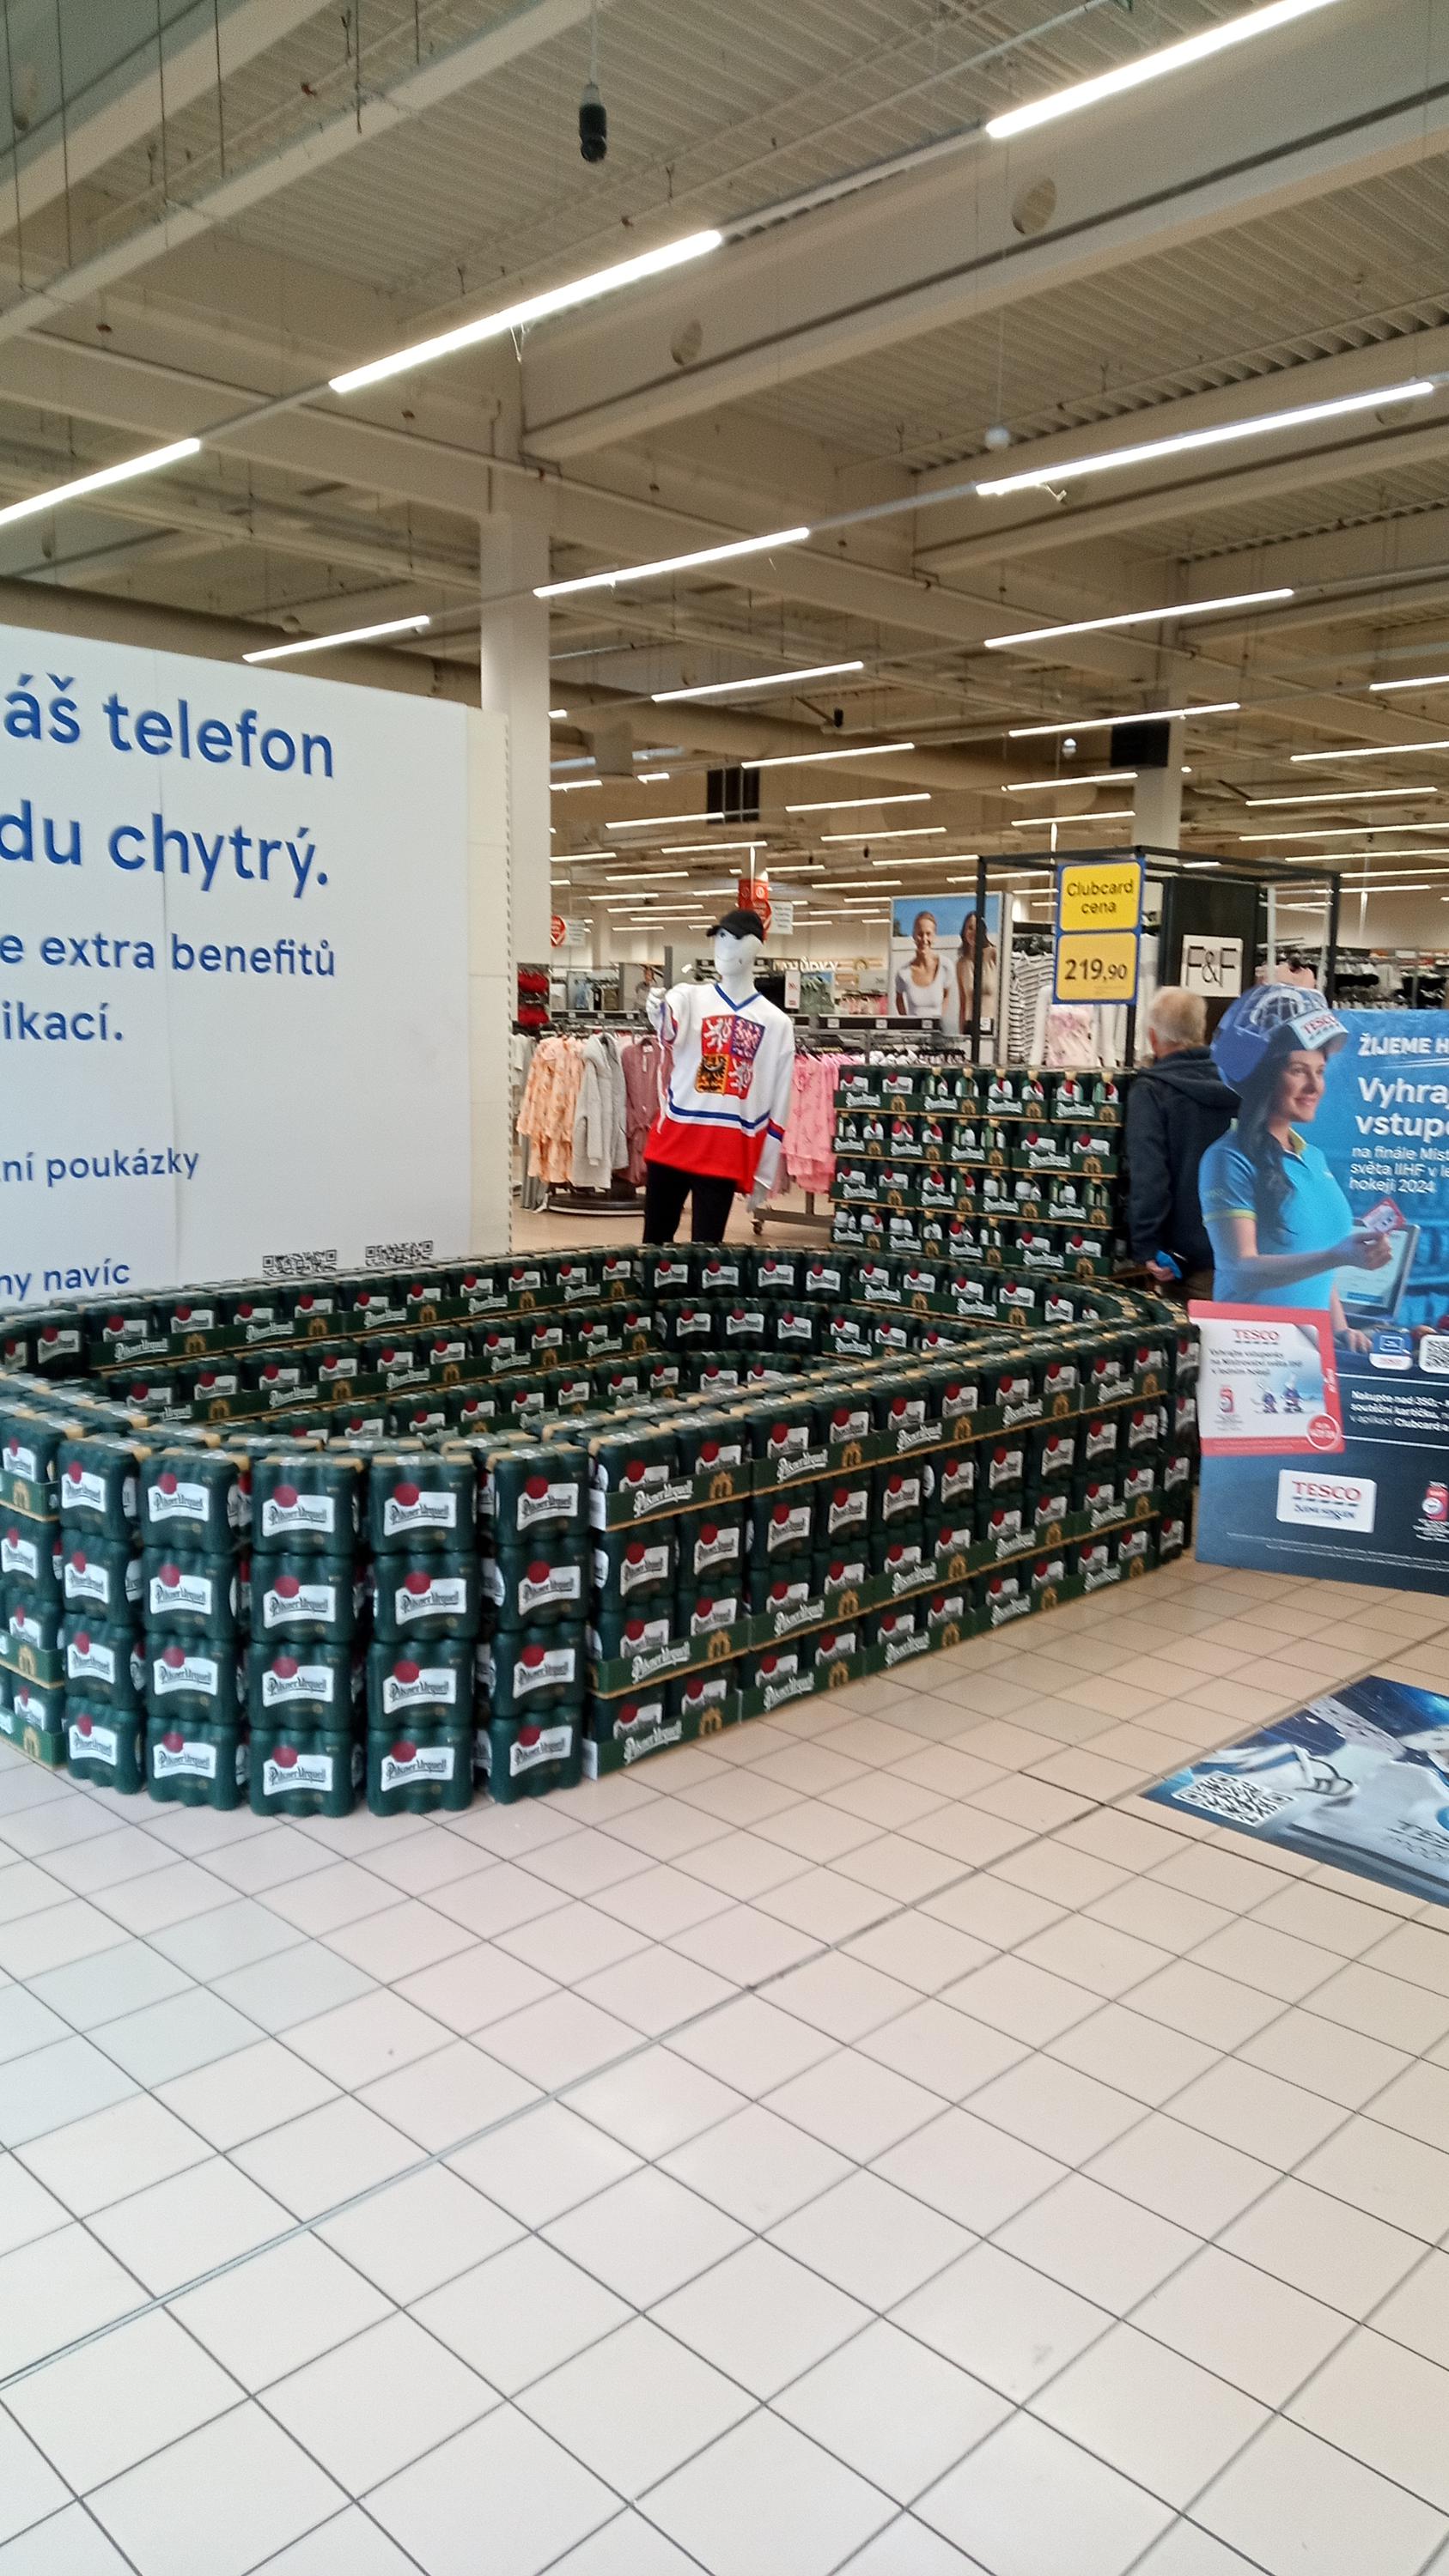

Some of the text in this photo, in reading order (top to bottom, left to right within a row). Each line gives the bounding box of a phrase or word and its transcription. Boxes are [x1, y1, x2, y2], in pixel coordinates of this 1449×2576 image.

[3, 672, 333, 778] áš telefon
[0, 799, 328, 899] du chytrý.
[1067, 879, 1134, 897] Clubcard
[1081, 901, 1117, 914] cena
[0, 932, 335, 976] e extra benefitů
[1186, 945, 1237, 987] F&F
[1064, 958, 1128, 982] 219,90
[2, 1000, 123, 1041] ikací.
[1358, 1032, 1432, 1056] ŽIJEME
[1357, 1076, 1449, 1110] Vyhra
[1355, 1113, 1449, 1144] vstup
[1352, 1147, 1373, 1159] na
[1374, 1145, 1417, 1161] finále
[3, 1147, 199, 1188] ní poukázky
[1349, 1161, 1392, 1176] světa
[1394, 1162, 1426, 1177] IIHF
[1428, 1166, 1438, 1178] v
[1349, 1176, 1437, 1195] hokeji 2024
[43, 1258, 131, 1291] navíc
[1233, 1327, 1280, 1342] TESCO
[1292, 1480, 1362, 1501] TESCO
